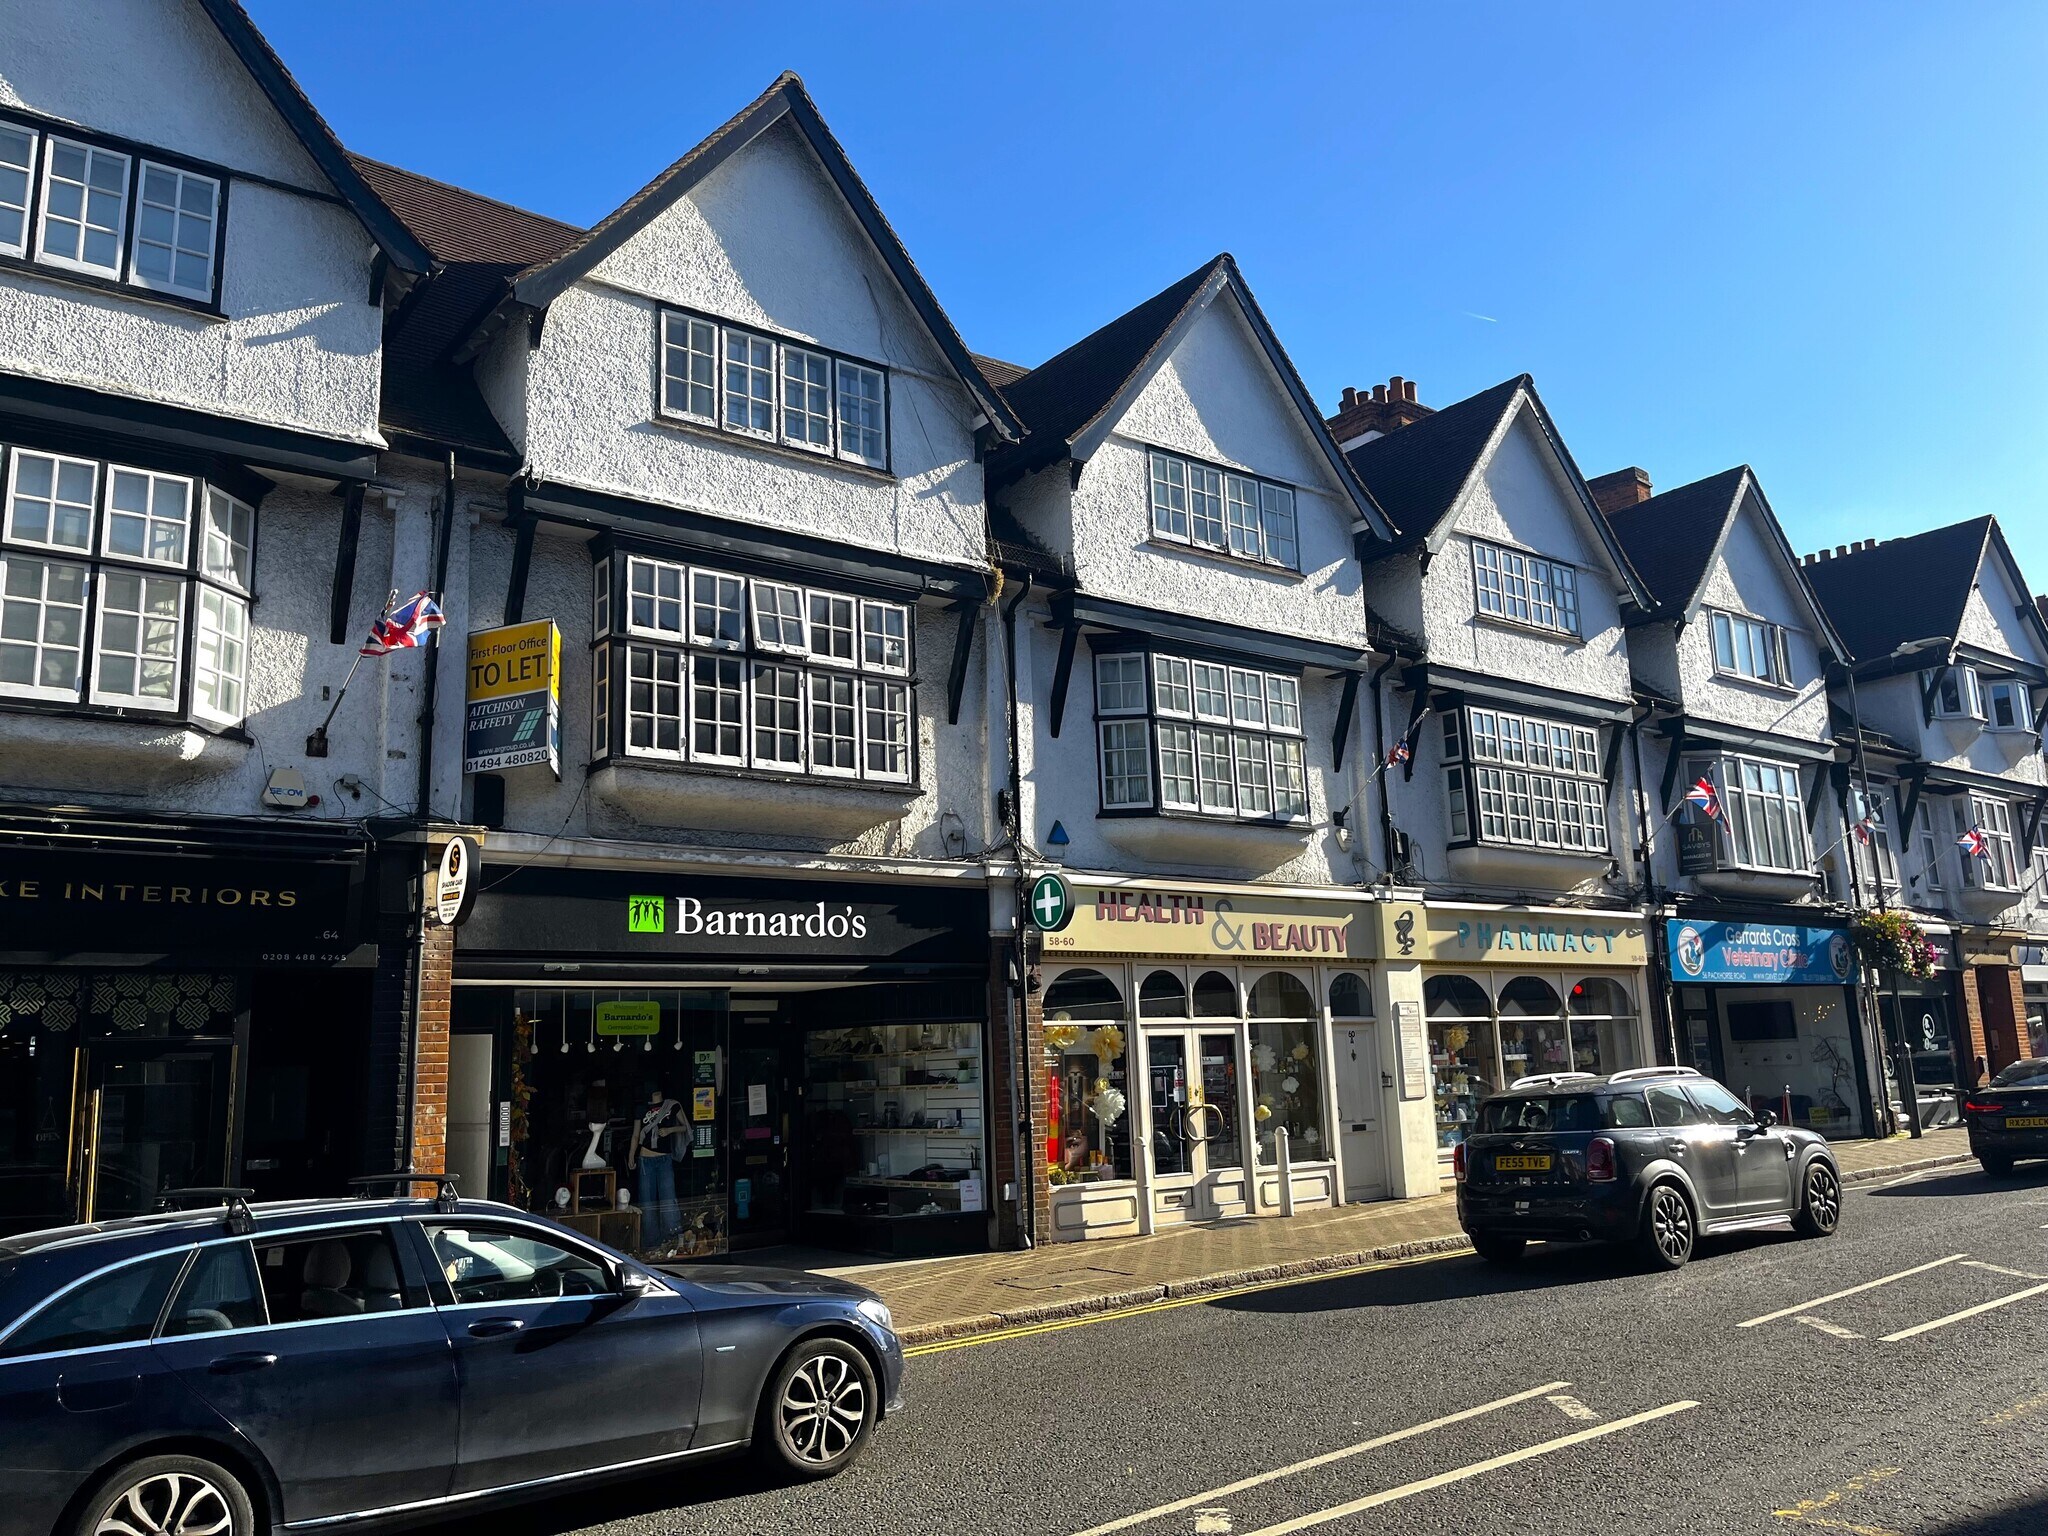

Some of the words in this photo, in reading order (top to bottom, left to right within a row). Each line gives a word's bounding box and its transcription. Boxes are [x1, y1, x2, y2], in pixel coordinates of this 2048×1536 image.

[471, 647, 490, 660] First
[492, 643, 517, 656] Floor
[519, 637, 547, 650] Office
[471, 662, 500, 689] TO
[507, 653, 546, 683] LET
[469, 698, 527, 717] AITCHISON
[469, 714, 516, 731] RAFFETY
[478, 740, 536, 755] www.argroup.co.uk
[466, 756, 502, 772] 01494
[505, 749, 548, 766] 480820
[65, 882, 296, 907] INTERIORS
[675, 896, 867, 939] Barnardo's
[1096, 890, 1204, 925] HEALTH
[1211, 899, 1247, 951] &
[1251, 922, 1347, 953] BEAUTY
[323, 930, 339, 940] 64
[1049, 936, 1075, 946] 58-60
[1456, 921, 1615, 953] PHARMACY
[1725, 926, 1771, 946] Gerrards
[1773, 928, 1800, 947] Cross
[262, 953, 290, 961] 0208
[1722, 946, 1779, 971] Veterinary
[2009, 1118, 2031, 1127] RX23
[1500, 1158, 1524, 1168] FE55
[1527, 1157, 1545, 1168] TVE
